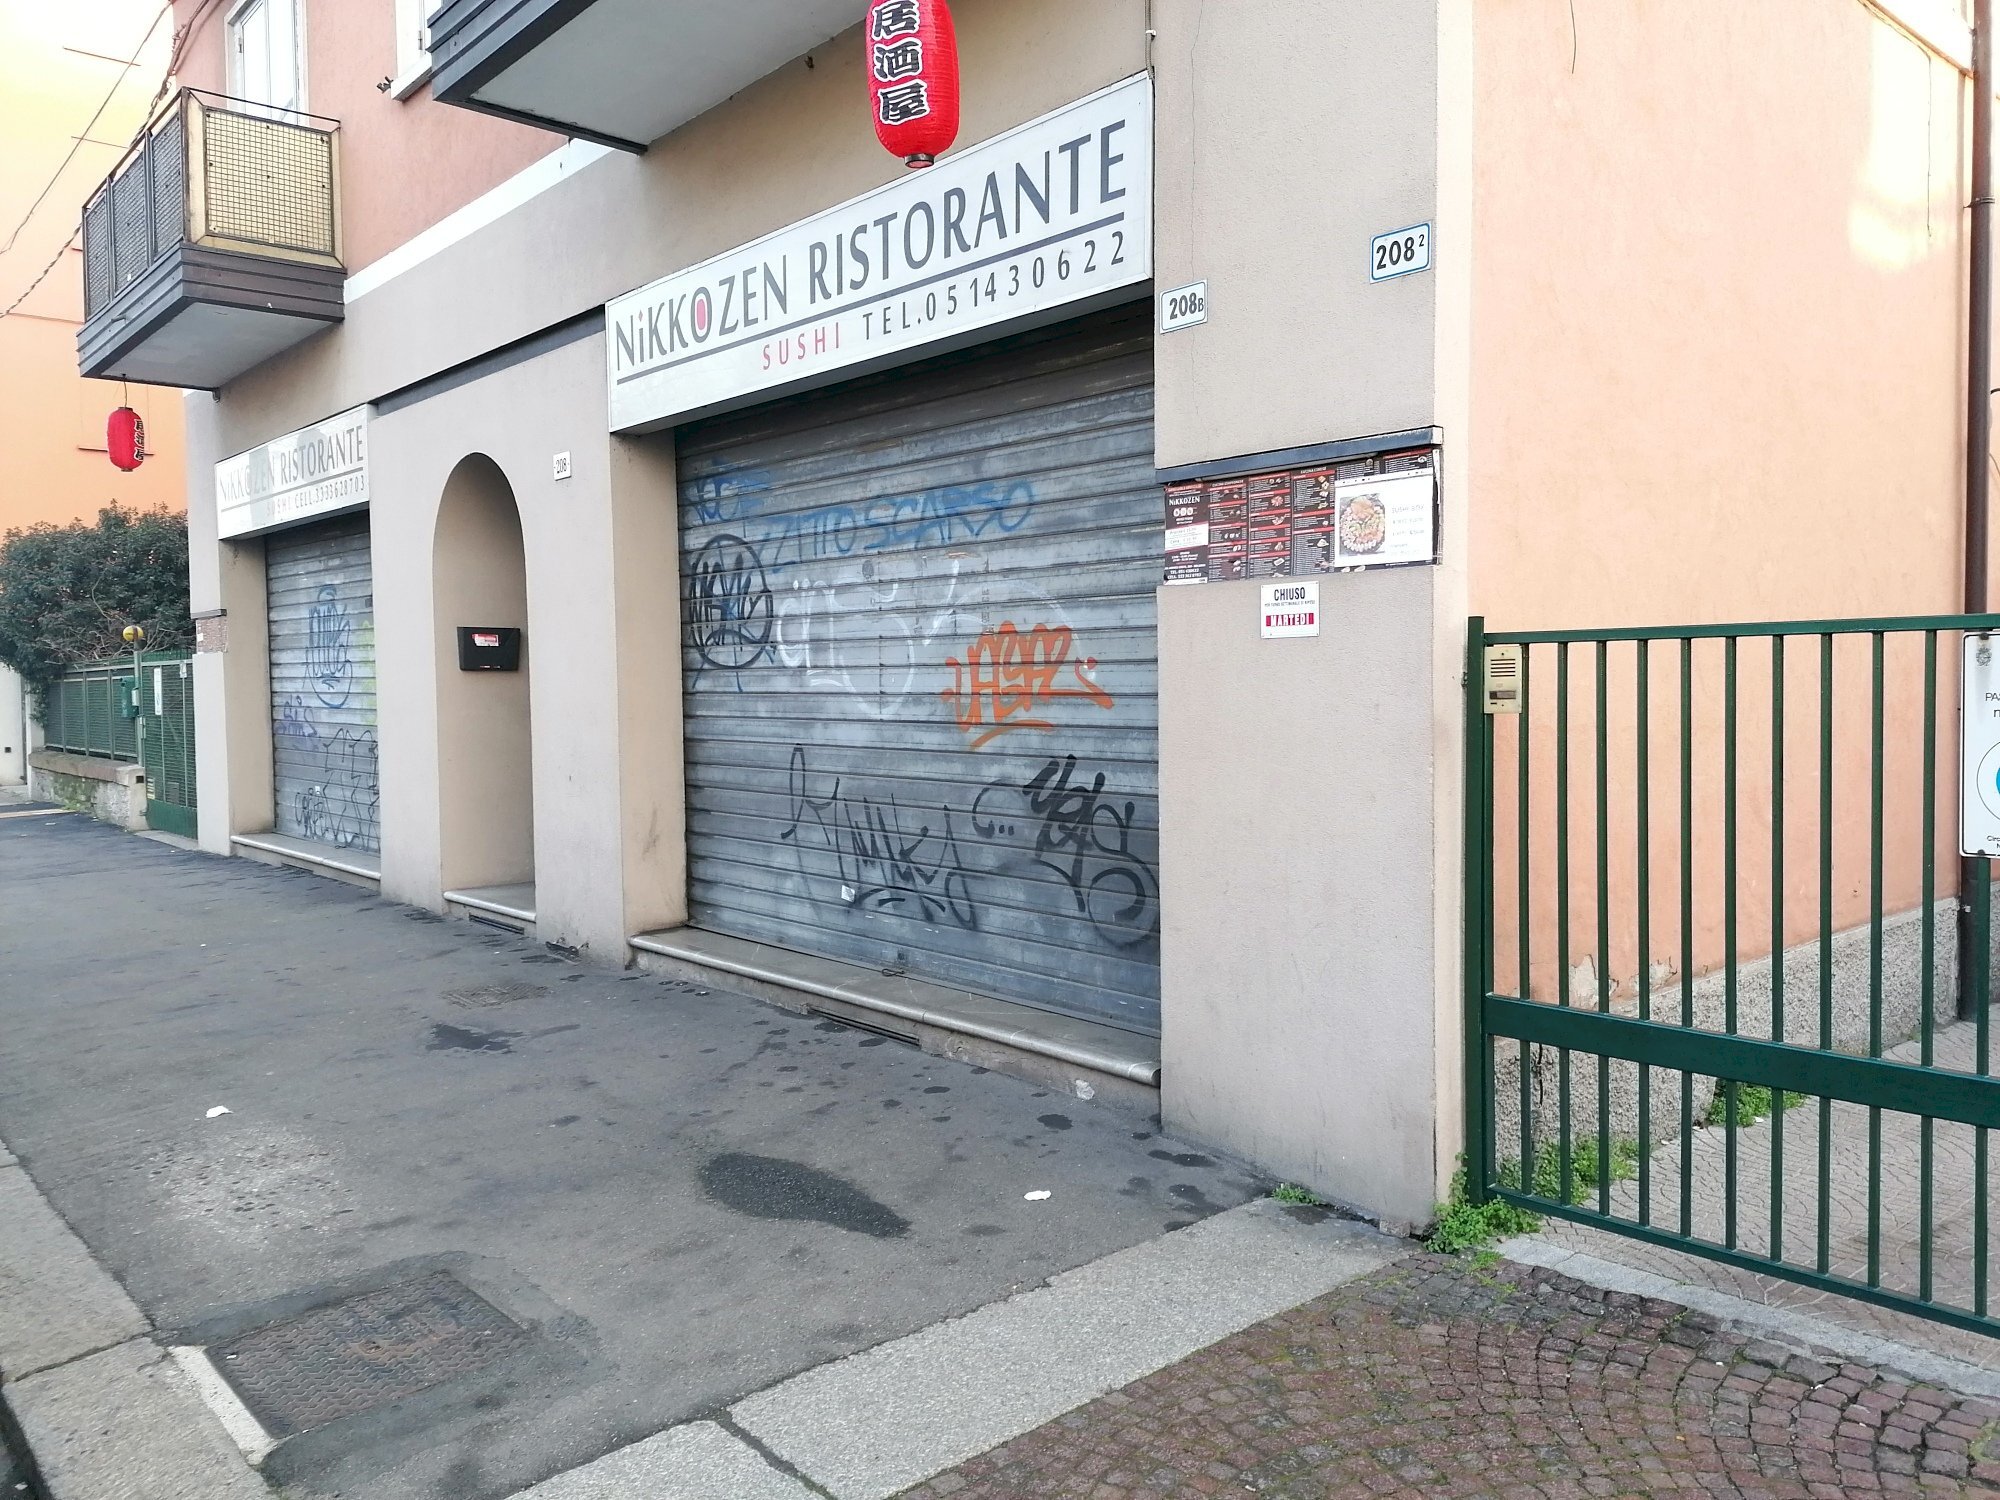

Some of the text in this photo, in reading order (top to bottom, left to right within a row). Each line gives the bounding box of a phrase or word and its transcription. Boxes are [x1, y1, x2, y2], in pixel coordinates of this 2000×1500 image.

[808, 118, 1127, 305] RISTORANTE
[762, 321, 841, 371] SUSHI
[280, 424, 364, 485] RISTORANTE
[1273, 587, 1306, 601] CHIUSO
[1985, 692, 2000, 701] PA
